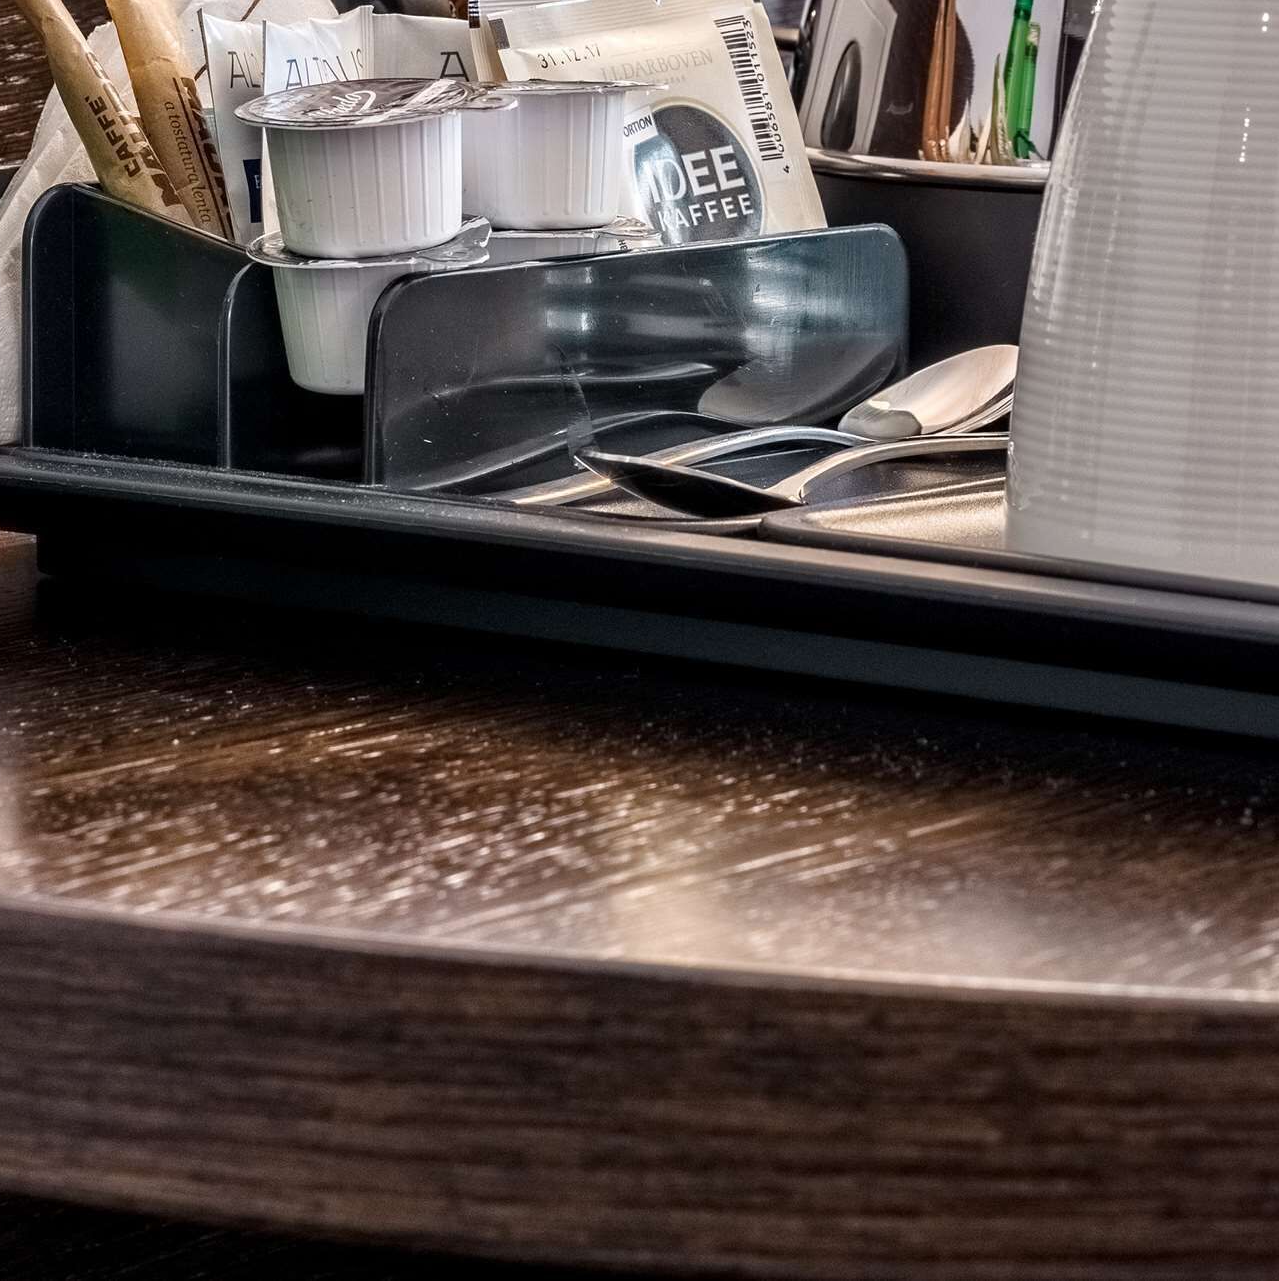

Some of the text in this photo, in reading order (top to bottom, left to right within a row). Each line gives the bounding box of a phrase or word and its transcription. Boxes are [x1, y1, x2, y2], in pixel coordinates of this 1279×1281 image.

[537, 43, 602, 69] 31.12.17
[623, 114, 653, 138] ORTION
[164, 101, 212, 223] a tostatura lenta
[641, 144, 746, 204] IDEE
[657, 193, 754, 232] KAFFEE
